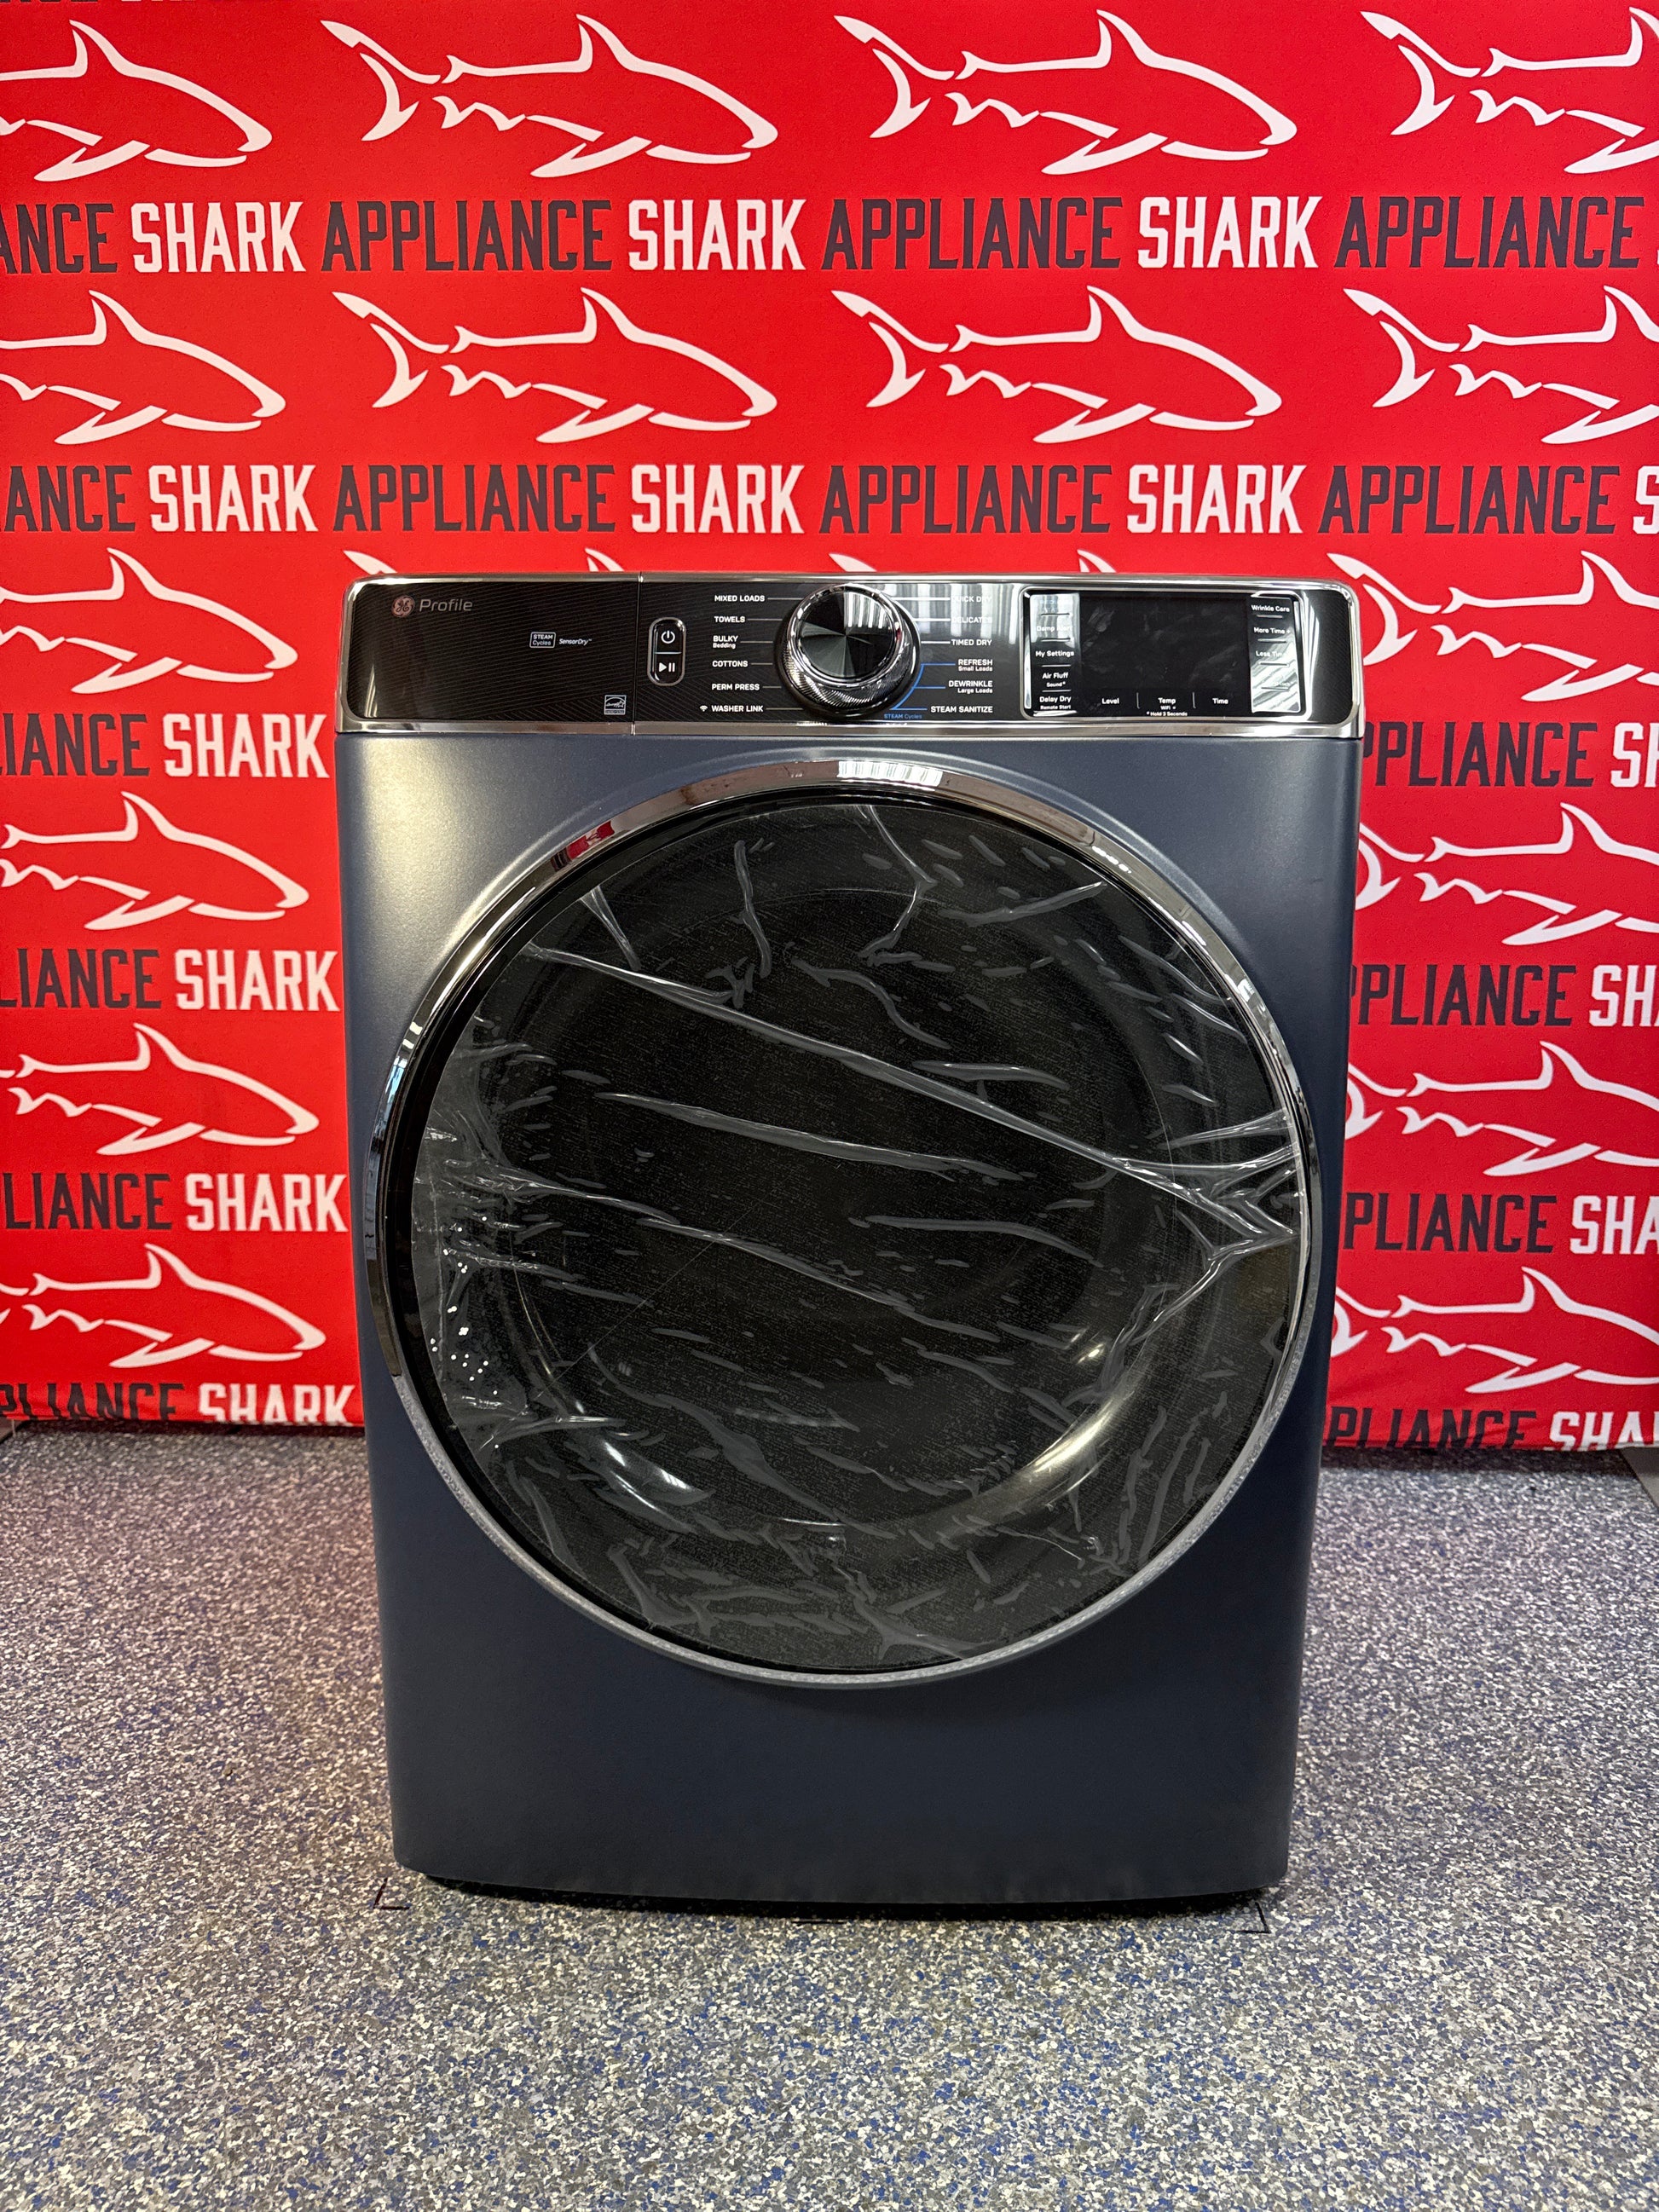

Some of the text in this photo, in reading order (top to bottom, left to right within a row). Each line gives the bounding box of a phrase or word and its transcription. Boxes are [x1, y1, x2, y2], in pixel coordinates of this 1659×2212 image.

[131, 202, 305, 272] SHARK
[322, 199, 805, 271] APPLIANCE SHARK
[822, 197, 1321, 269] APPLIANCE SHARK
[1335, 197, 1644, 268] APPLIANCE
[5, 465, 317, 531] ANCE SHARK
[334, 465, 803, 533] APPLIANCE SHARK
[820, 465, 1306, 533] APPLIANCE SHARK
[1319, 466, 1619, 534] APPLIANCE
[419, 598, 473, 612] Profile
[1036, 625, 1055, 633] Damp
[1046, 650, 1075, 658] Settings
[1059, 695, 1072, 703] Dry
[0, 713, 328, 777] IANCE SHARK
[176, 950, 338, 1011] SHARK
[1352, 964, 1659, 1026] PLIANCE SH
[3, 1173, 346, 1231] LIANCE SHARK
[1343, 1193, 1557, 1252] PLIANCE
[199, 1383, 356, 1425] SHARK
